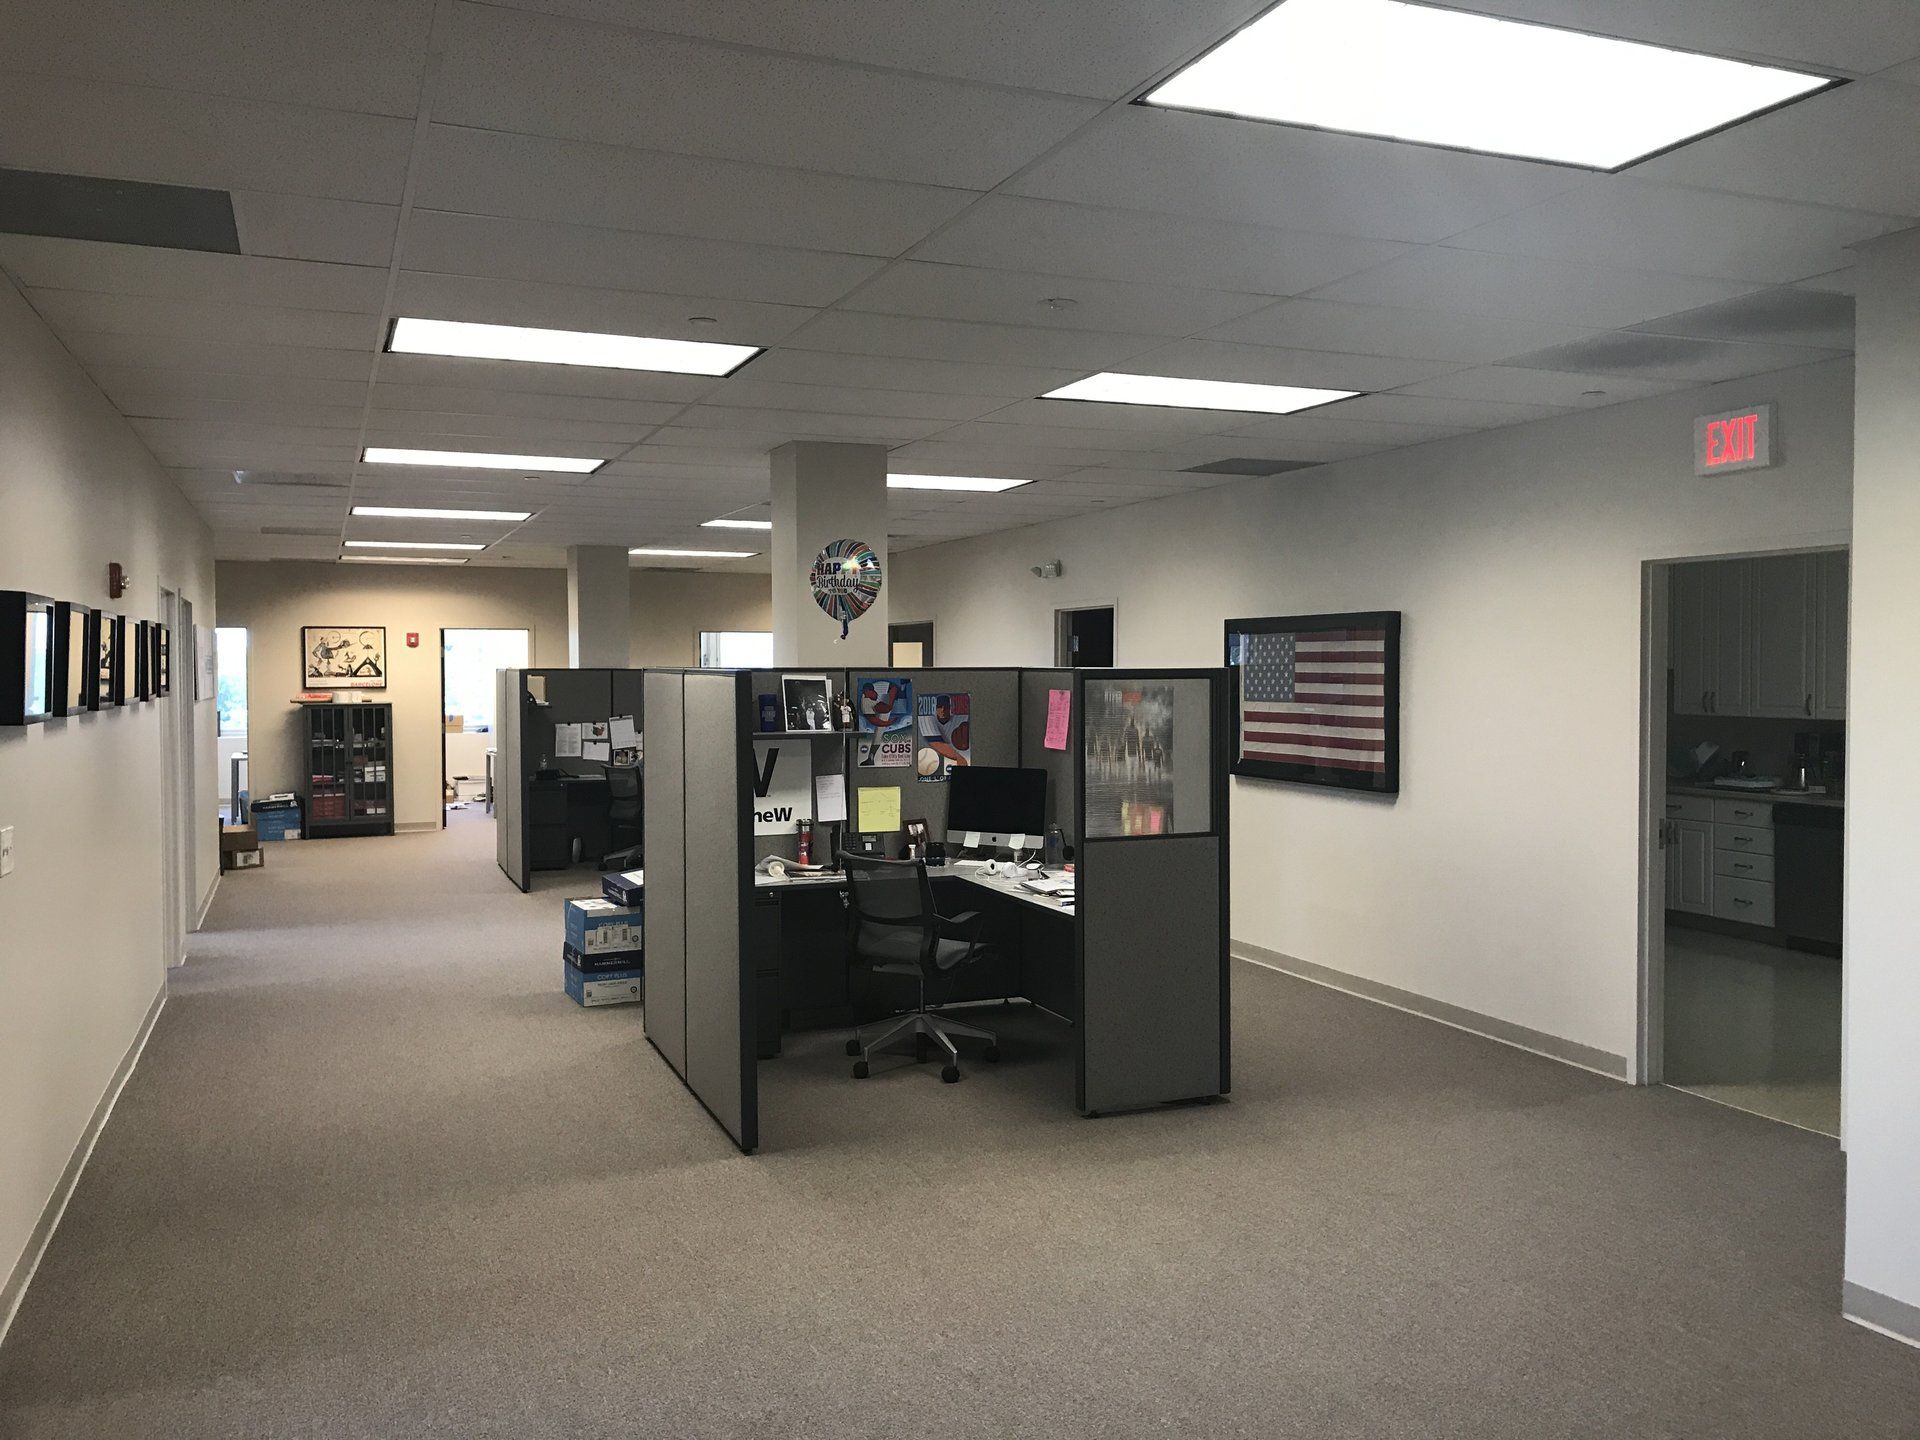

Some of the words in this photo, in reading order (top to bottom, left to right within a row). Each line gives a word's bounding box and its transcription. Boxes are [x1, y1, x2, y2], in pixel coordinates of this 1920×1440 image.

[1706, 414, 1758, 466] EXIT
[816, 562, 860, 575] HAP
[881, 744, 911, 754] CUBS
